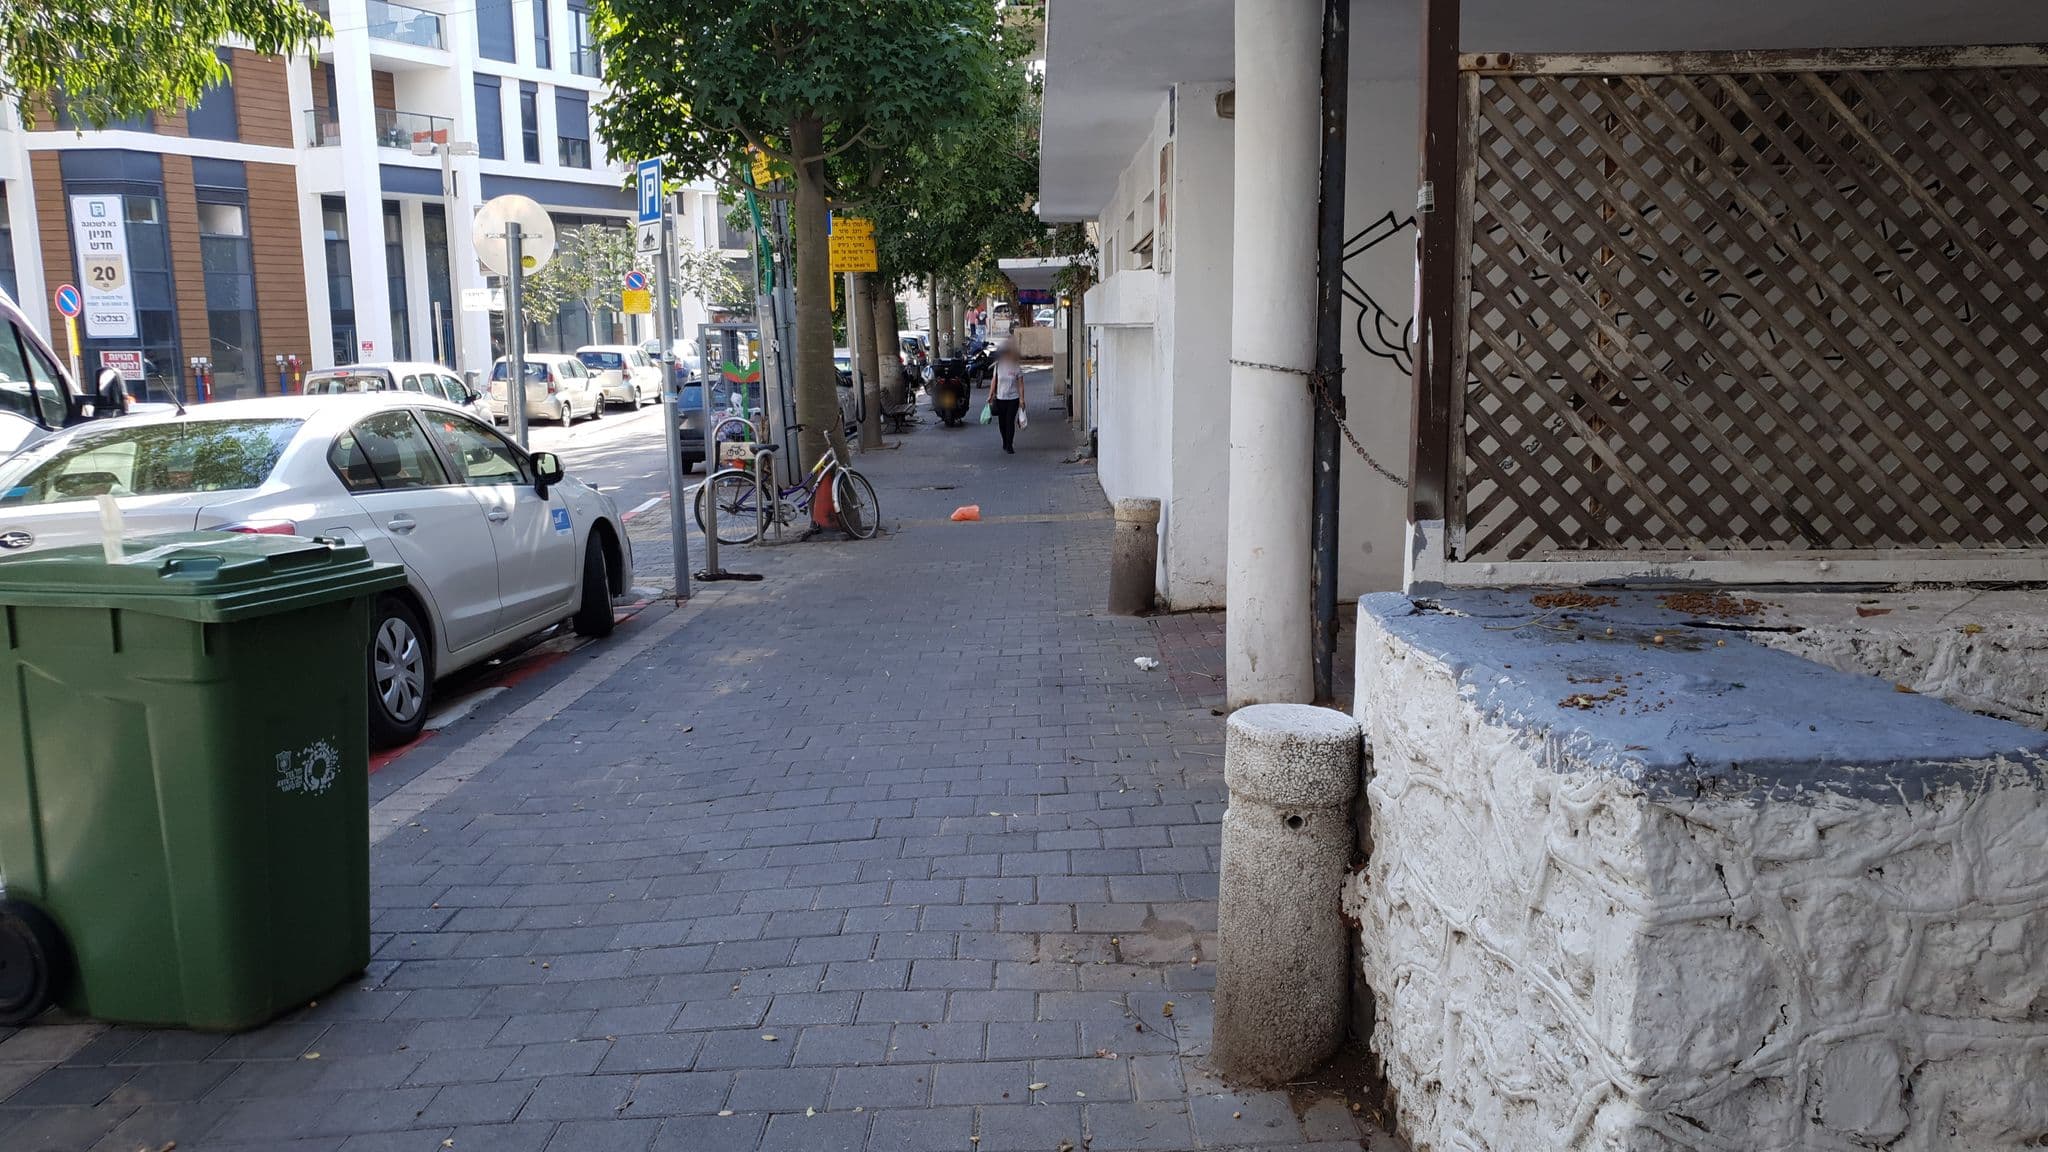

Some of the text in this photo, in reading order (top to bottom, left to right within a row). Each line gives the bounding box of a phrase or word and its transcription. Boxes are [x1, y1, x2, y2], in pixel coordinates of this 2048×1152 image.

[88, 230, 112, 240] חניון
[90, 242, 113, 250] חדש
[93, 266, 116, 281] 20
